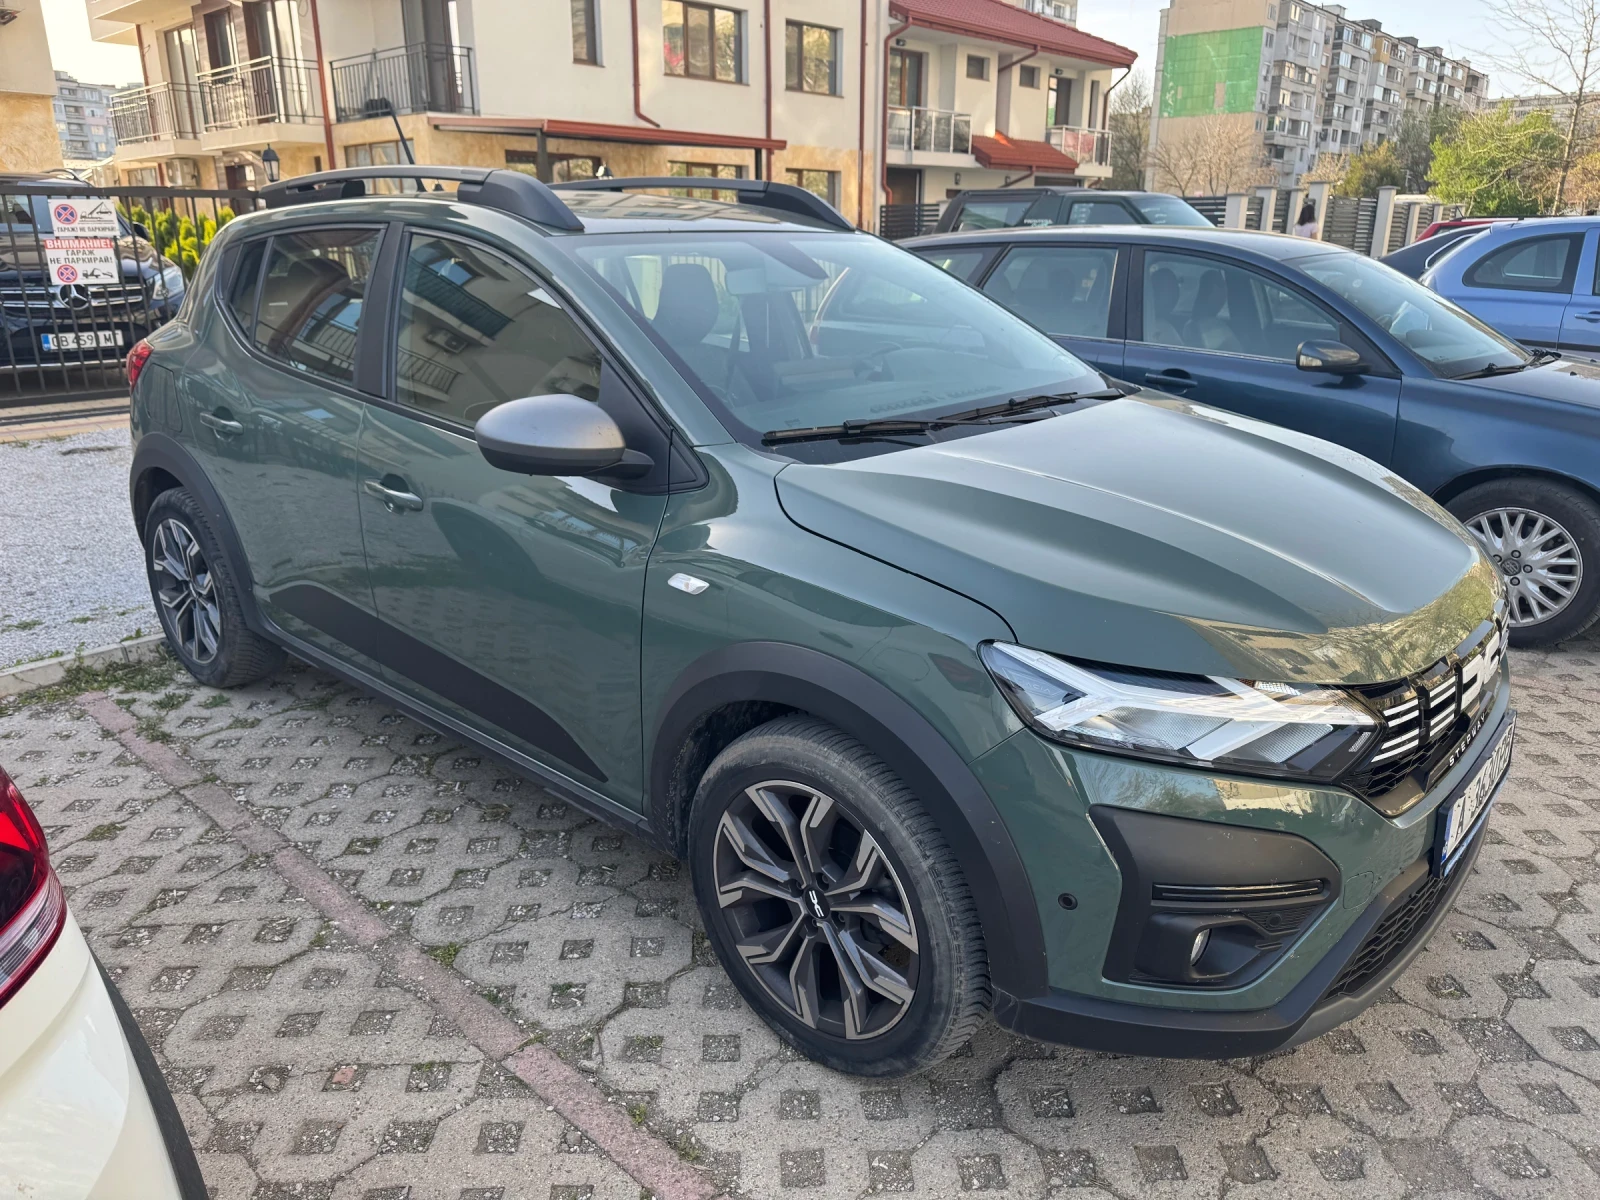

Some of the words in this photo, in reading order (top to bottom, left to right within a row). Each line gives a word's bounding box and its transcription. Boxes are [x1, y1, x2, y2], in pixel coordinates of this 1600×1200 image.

[46, 239, 112, 249] ВНИМАНИЕ!
[49, 257, 62, 265] НЕ
[64, 255, 114, 265] ПАРКИРАЙ!
[1449, 712, 1486, 767] STEPWAY
